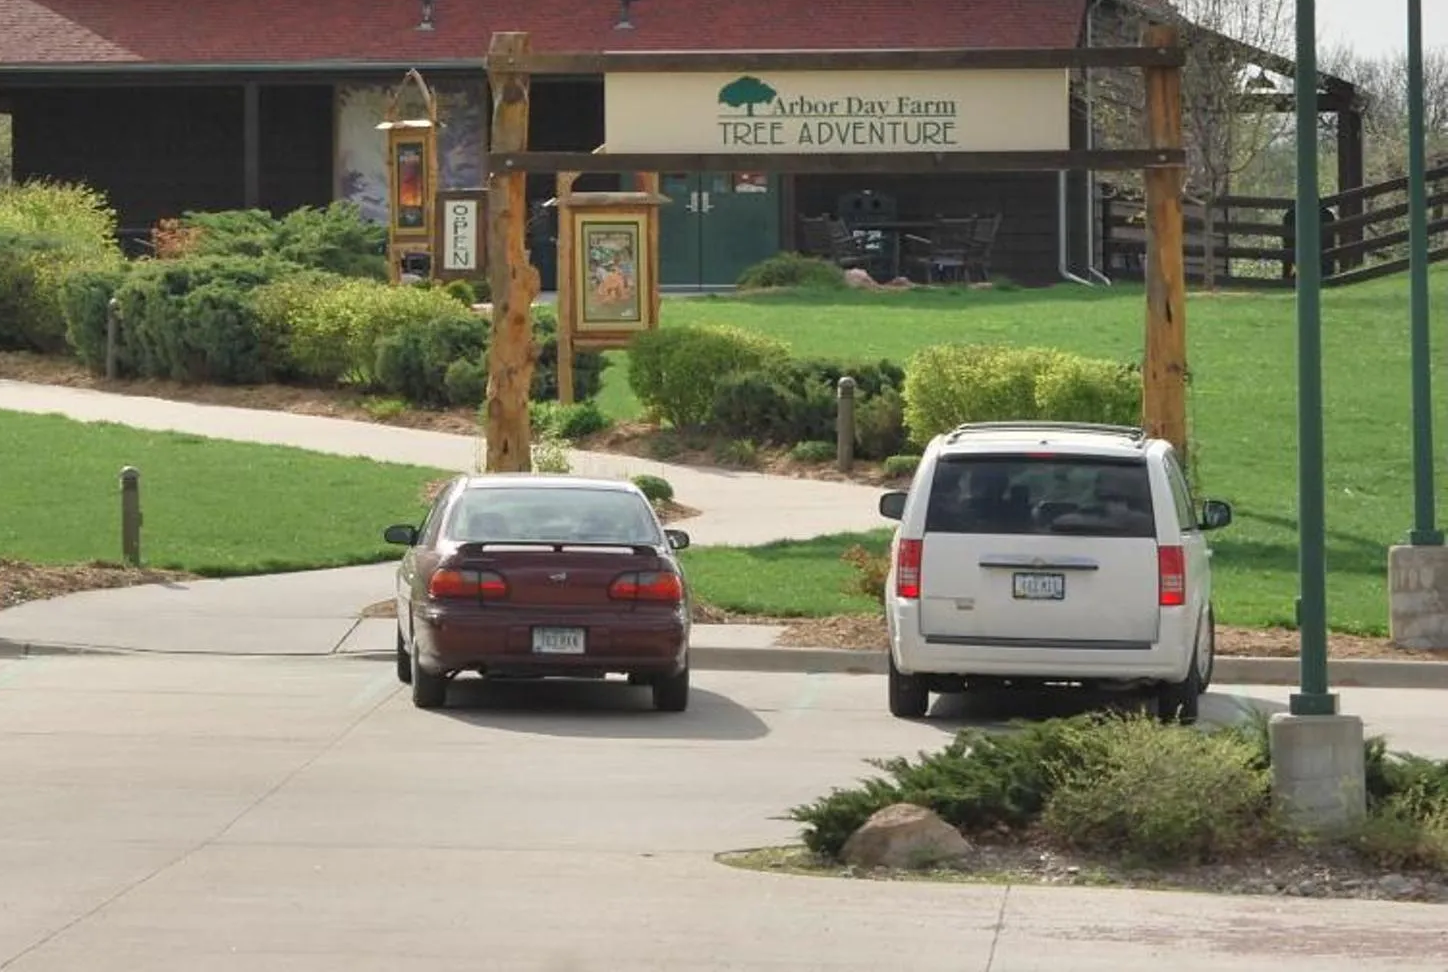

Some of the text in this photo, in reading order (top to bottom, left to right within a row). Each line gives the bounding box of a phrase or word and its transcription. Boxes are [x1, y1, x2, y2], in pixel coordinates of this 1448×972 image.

[772, 96, 956, 119] Arbor Day Farm
[718, 121, 958, 145] TREE ADVENTURE
[453, 205, 469, 266] OPEN
